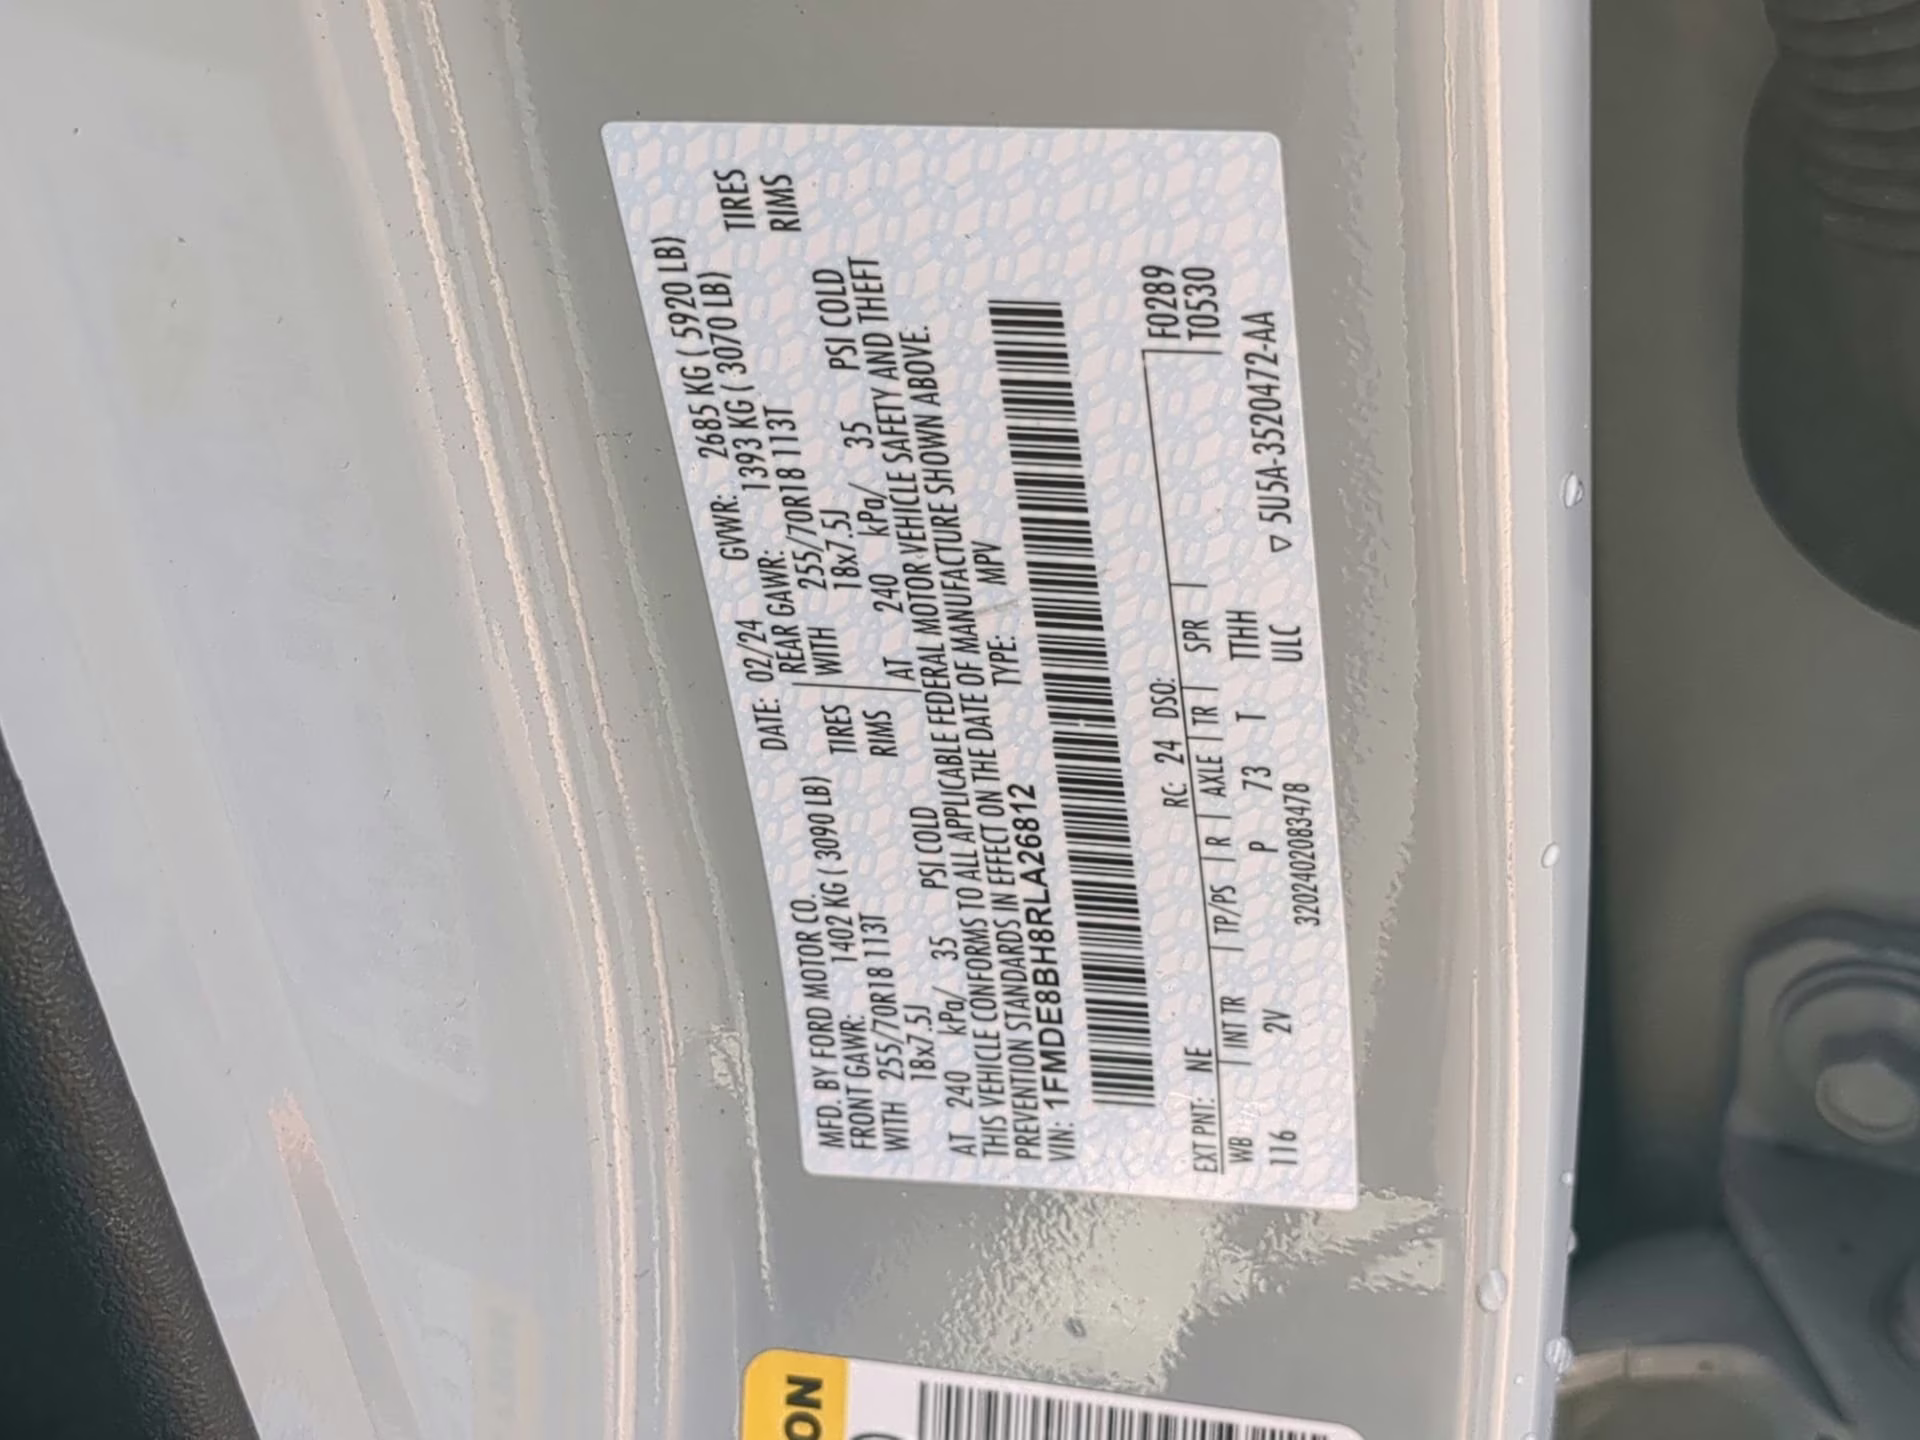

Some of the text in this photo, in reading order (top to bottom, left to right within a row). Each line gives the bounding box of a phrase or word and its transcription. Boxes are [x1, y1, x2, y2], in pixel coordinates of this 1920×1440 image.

[650, 236, 688, 272] LB)
[662, 282, 702, 339] 5920
[696, 272, 733, 307] LB)
[812, 269, 852, 327] COLD
[1140, 265, 1180, 338] F0289
[1181, 267, 1220, 340] T0530
[706, 317, 746, 374] 3070
[824, 338, 860, 370] PSI
[680, 366, 714, 395] KG
[760, 174, 862, 589] 18x7.5J RIMS
[688, 404, 728, 458] 2685
[713, 169, 842, 676] WITH 255/70R18 113T TIRES
[724, 400, 758, 428] KG
[840, 422, 874, 448] 35
[1242, 312, 1292, 524] 5U5A-3520472-AA
[732, 438, 770, 490] 1393
[710, 496, 749, 560] GVWR:
[757, 550, 795, 616] GAWR:
[868, 574, 904, 613] 240
[971, 541, 1022, 686] TYPE: MPV
[770, 625, 807, 674] REAR
[882, 656, 915, 680] AT
[1268, 624, 1303, 662] ULC
[736, 620, 788, 750] DATE: 02/24
[848, 256, 1008, 1156] THIS VEHICLE CONFORMS TO ALL APPLICABLE FEDERAL MOTOR VEHICLE SAFETY AND THEFT
[899, 326, 1040, 1159] PREVENTION STANDARDS IN EFFECT ON THE DATE OF MANUFACTURE SHOWN ABOVE.
[1150, 678, 1188, 808] RC: 24 DSO:
[800, 776, 832, 806] LB)
[808, 813, 842, 860] 3090
[910, 806, 943, 854] COLD
[1282, 783, 1320, 926] 3202402083478
[820, 883, 850, 908] KG
[862, 710, 936, 1080] 18x7.5J RIMS
[918, 862, 948, 889] PSI
[1182, 620, 1252, 1162] WB INT TR TP/PS R AXLE TR SPR
[1226, 610, 1297, 1164] 116 2V P 73 T TTHH
[820, 705, 909, 1151] WITH 255/70R18 113T TIRES
[825, 916, 857, 962] 1402
[929, 936, 958, 960] 35
[1007, 784, 1074, 1161] VIN: 1FMDE8BH8RLA26812
[790, 894, 843, 1148] MFD. BY FORD MOTOR CO.
[839, 1016, 870, 1077] GAWR:
[846, 1086, 876, 1149] FRONT
[944, 1071, 973, 1108] 240
[1184, 1048, 1218, 1172] EXT PNT: NE
[948, 1132, 976, 1156] AT
